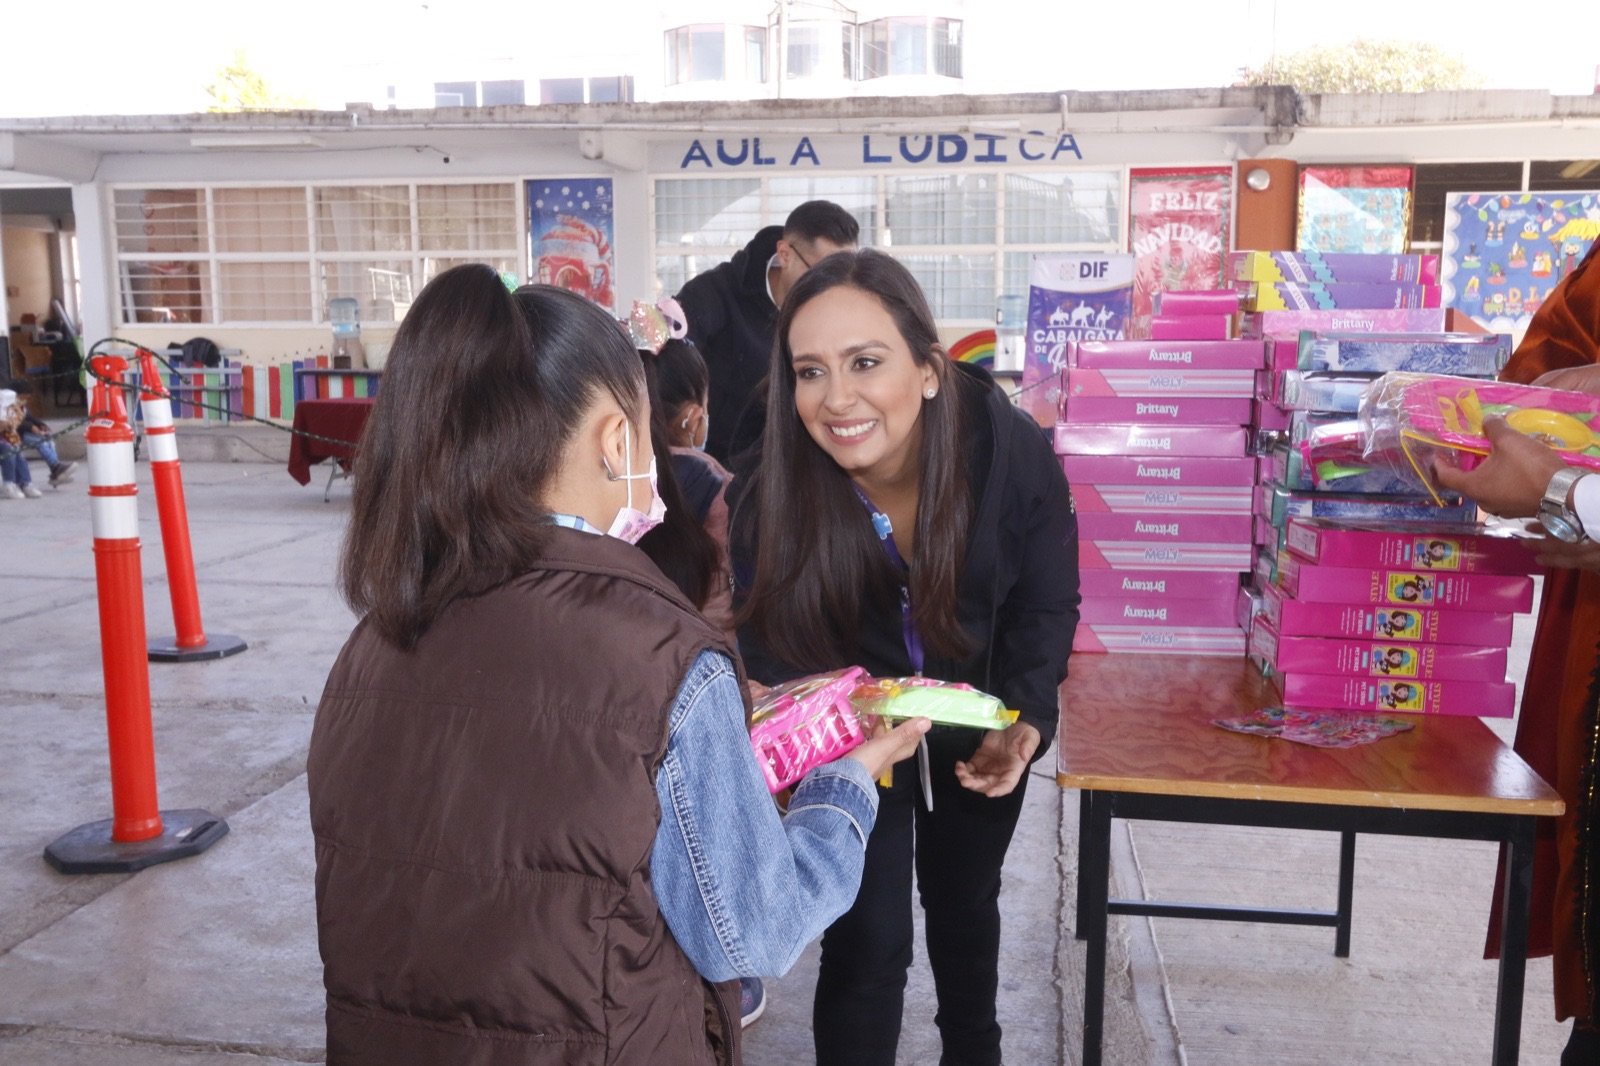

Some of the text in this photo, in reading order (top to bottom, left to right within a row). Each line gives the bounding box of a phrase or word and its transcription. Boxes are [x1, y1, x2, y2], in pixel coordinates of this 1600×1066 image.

[680, 136, 821, 169] AULA
[1149, 191, 1218, 211] FELIZ
[1133, 222, 1222, 257] NAVIDAD
[1079, 261, 1109, 278] DIF
[1331, 317, 1374, 332] Brittany
[1034, 345, 1048, 354] DE
[1149, 348, 1192, 364] Brittany
[1136, 402, 1179, 417] Brittany
[1136, 464, 1181, 480] Brittany
[1135, 520, 1179, 536] Brittany
[1122, 577, 1166, 593] Brittany
[1124, 605, 1167, 620] Brittany
